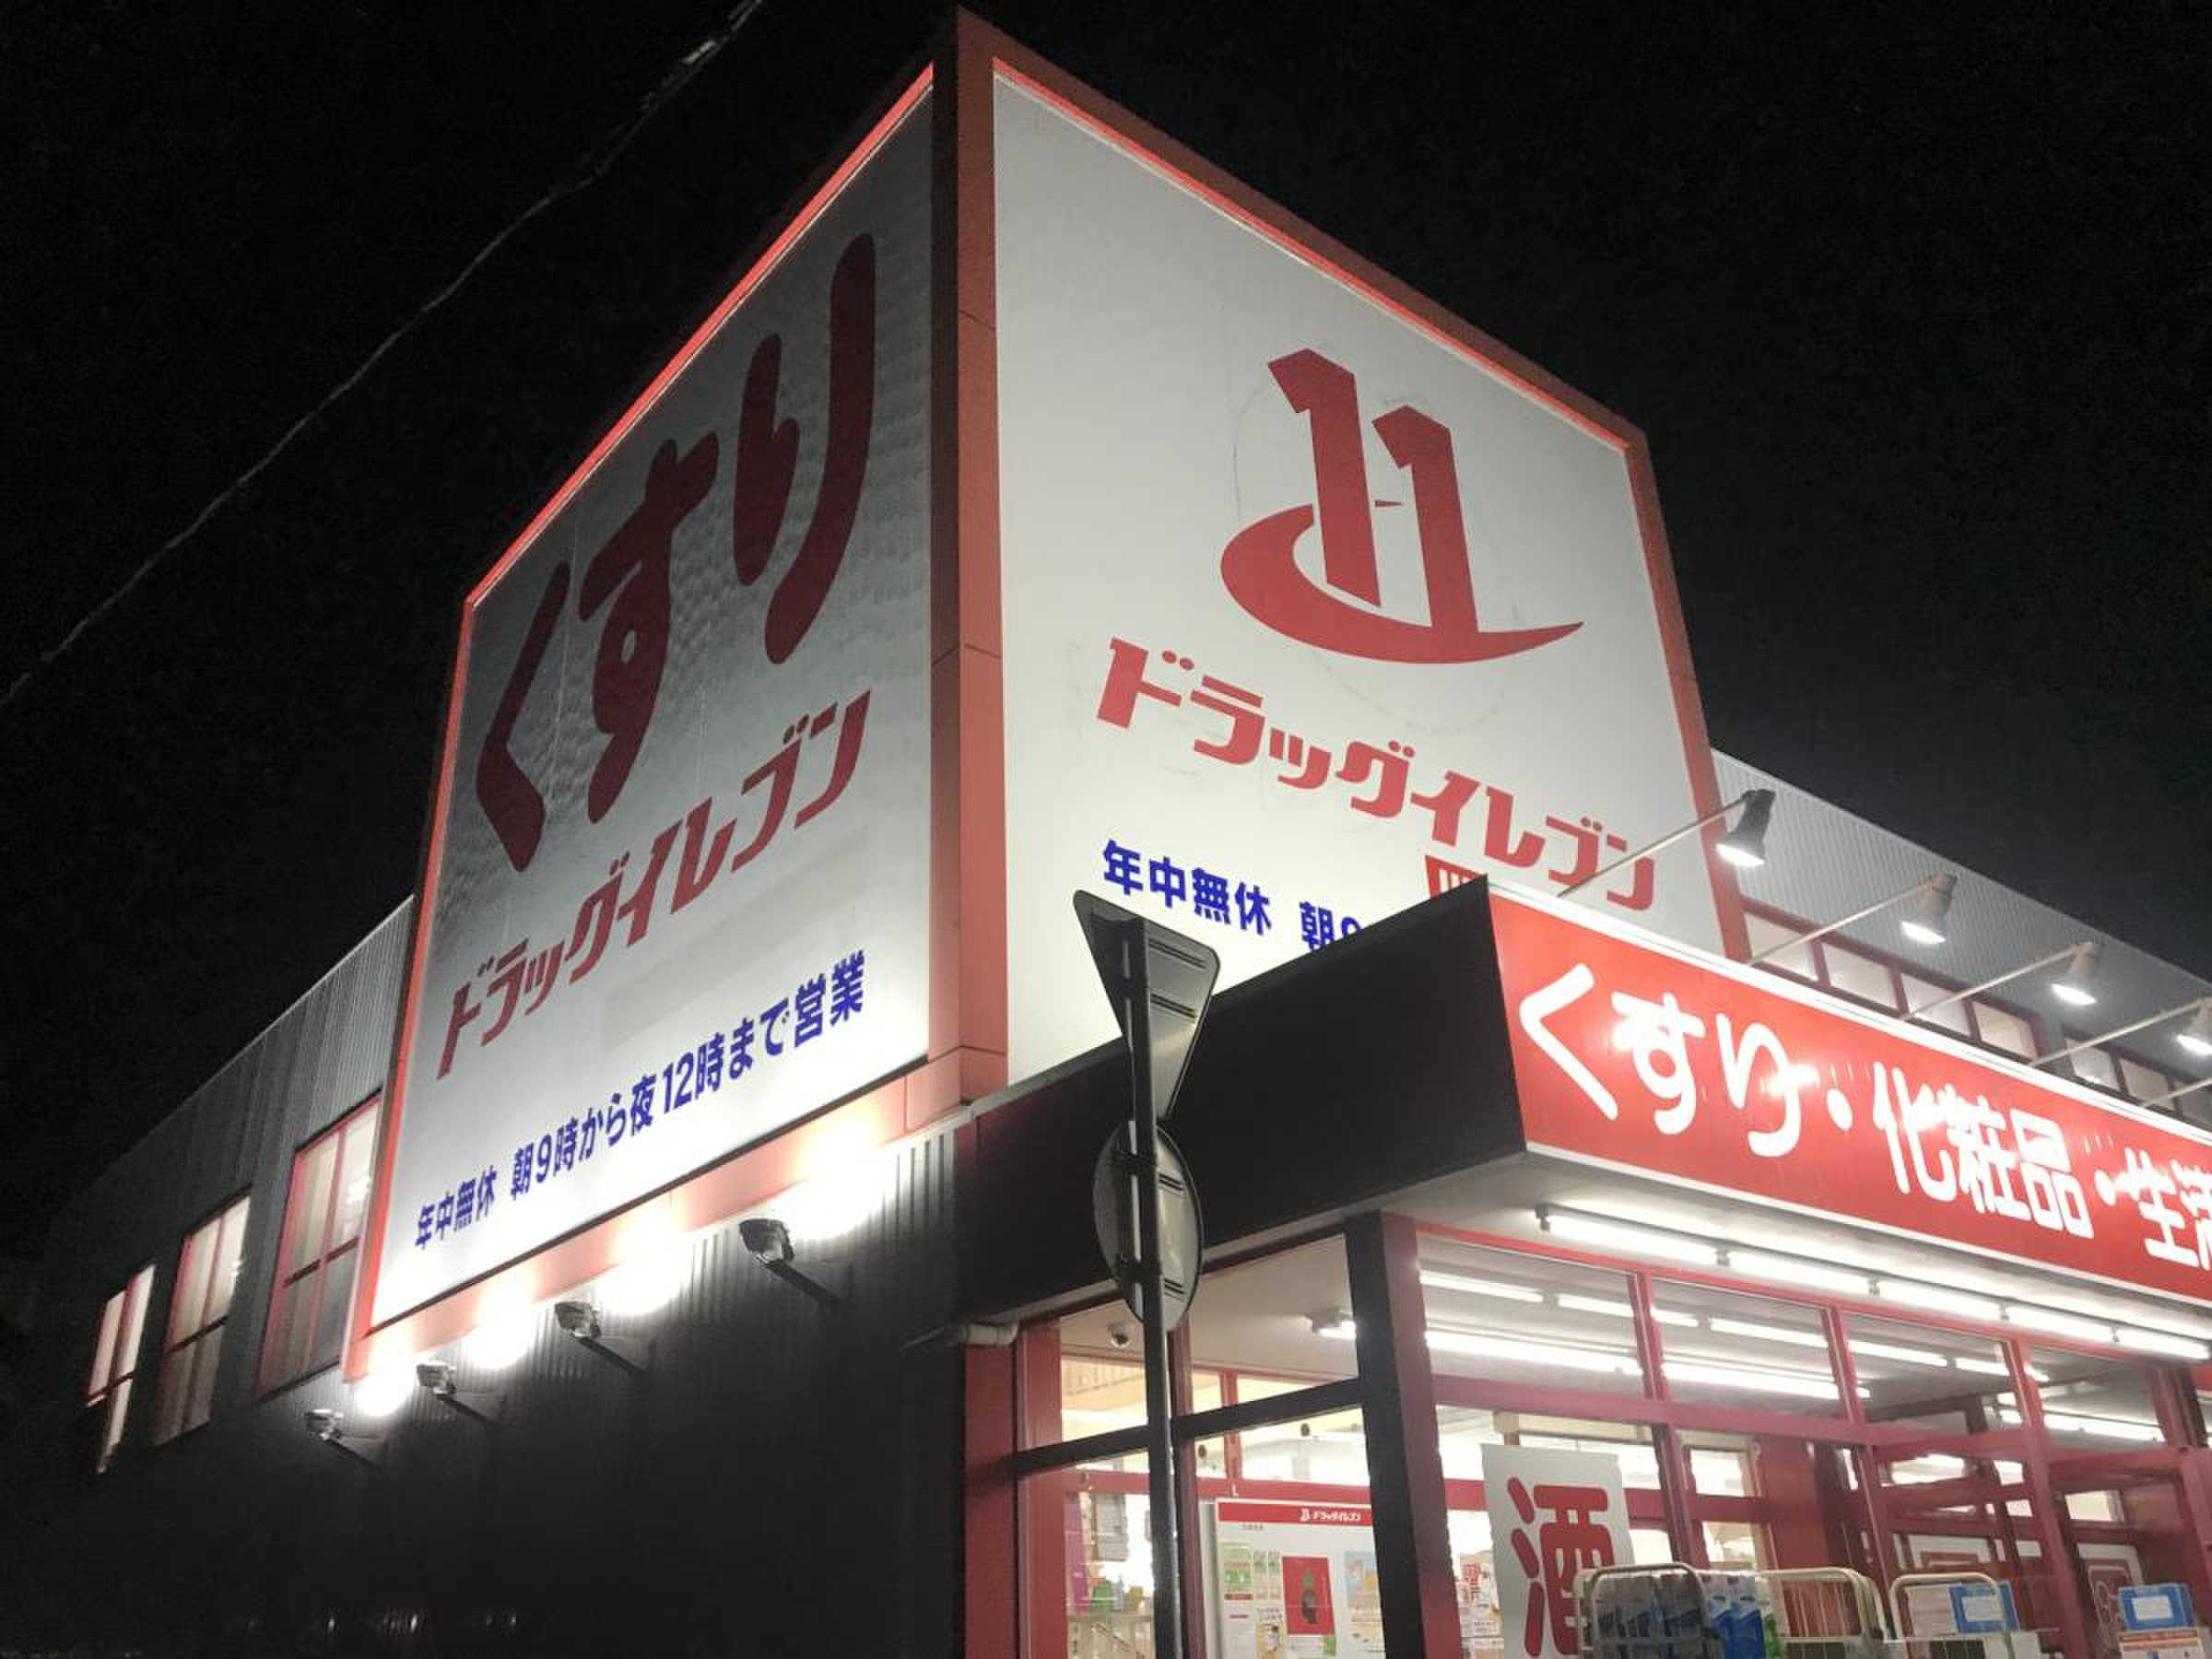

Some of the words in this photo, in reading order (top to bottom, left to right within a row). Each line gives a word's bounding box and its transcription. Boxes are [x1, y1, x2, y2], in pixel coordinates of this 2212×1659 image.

[475, 233, 876, 872] くすり
[437, 689, 871, 1079] ドラッグイレブン
[1097, 637, 1655, 911] ドラッグイレブン
[1102, 840, 1271, 935] 年中無休
[415, 1164, 498, 1251] 年中無休
[509, 950, 865, 1201] 朝9時から夜12時まで営業
